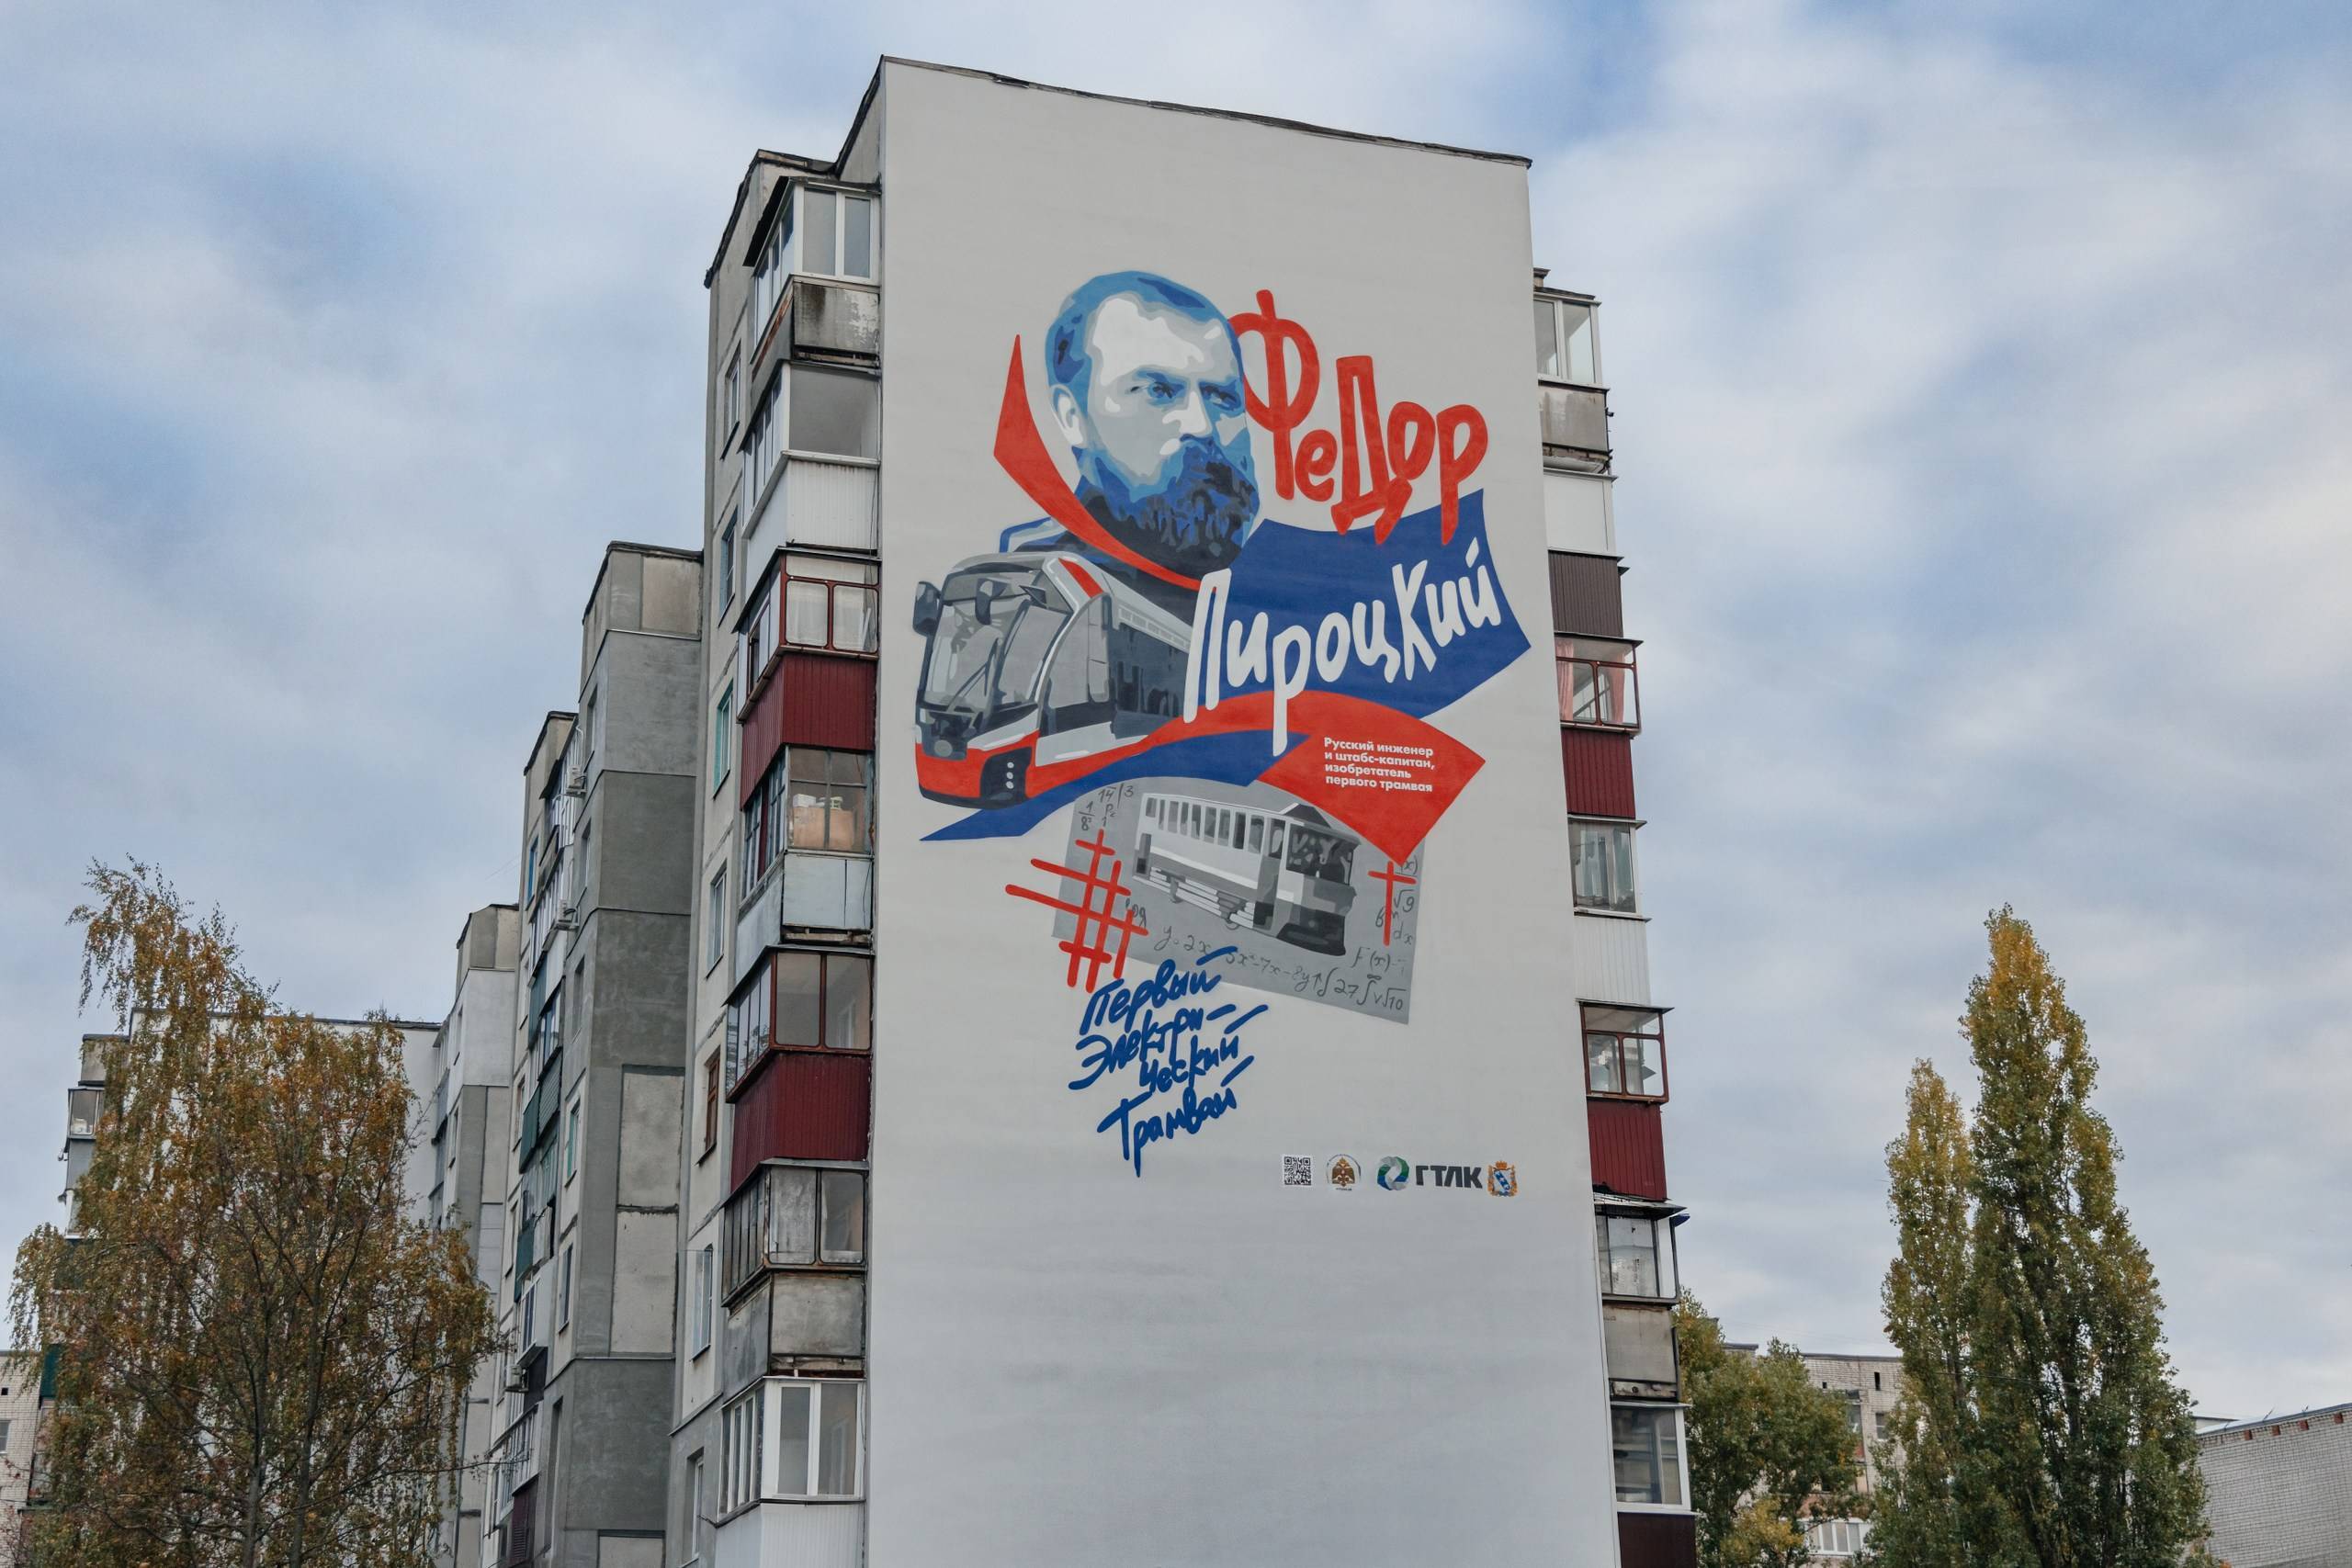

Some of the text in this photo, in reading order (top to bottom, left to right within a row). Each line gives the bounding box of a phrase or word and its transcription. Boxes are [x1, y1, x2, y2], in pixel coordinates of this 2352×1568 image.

[1324, 737, 1433, 757] Русский инженер
[1324, 751, 1435, 770] и штабс-капитан,
[1325, 763, 1411, 779] изобретатель
[1326, 775, 1433, 792] первого трамвая
[1080, 945, 1238, 1035] Первый
[1096, 1055, 1255, 1178] Трамвай
[1416, 1165, 1483, 1189] ГТЛК
